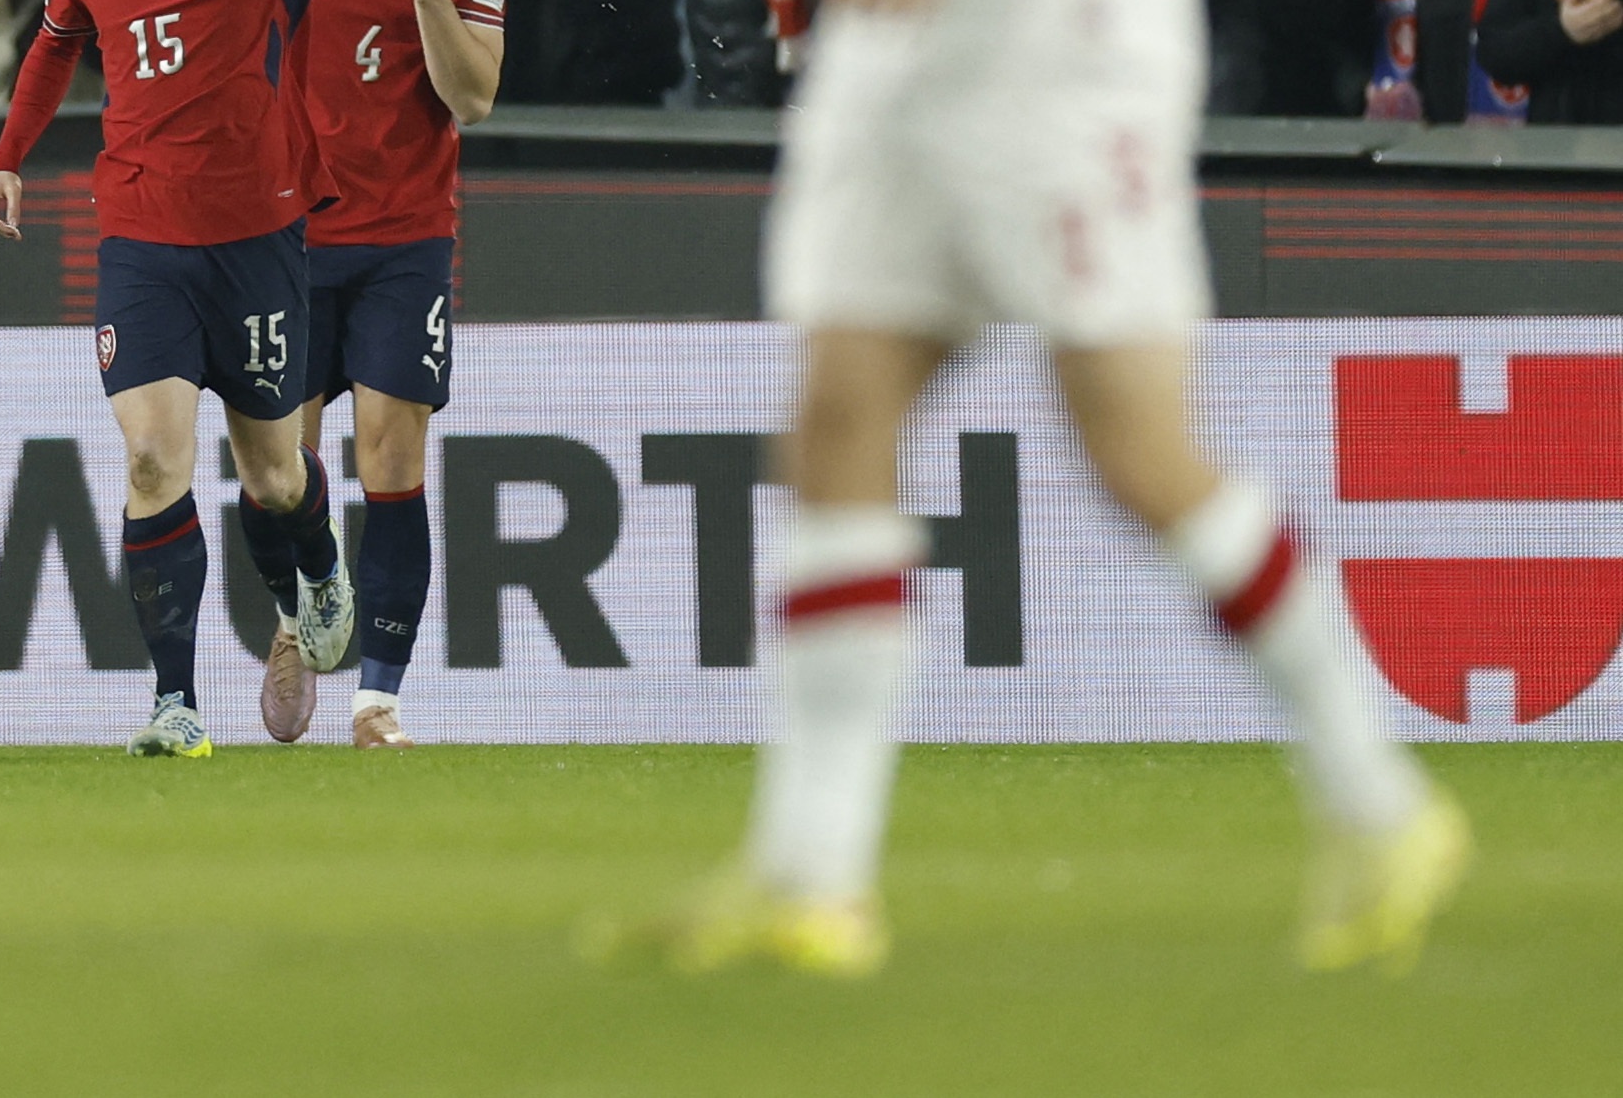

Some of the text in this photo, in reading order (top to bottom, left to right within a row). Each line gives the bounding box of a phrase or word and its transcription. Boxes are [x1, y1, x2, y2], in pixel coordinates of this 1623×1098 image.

[128, 12, 184, 79] 15
[356, 25, 382, 81] 4
[243, 310, 287, 372] 15
[426, 295, 445, 352] 4
[374, 617, 409, 635] CZE
